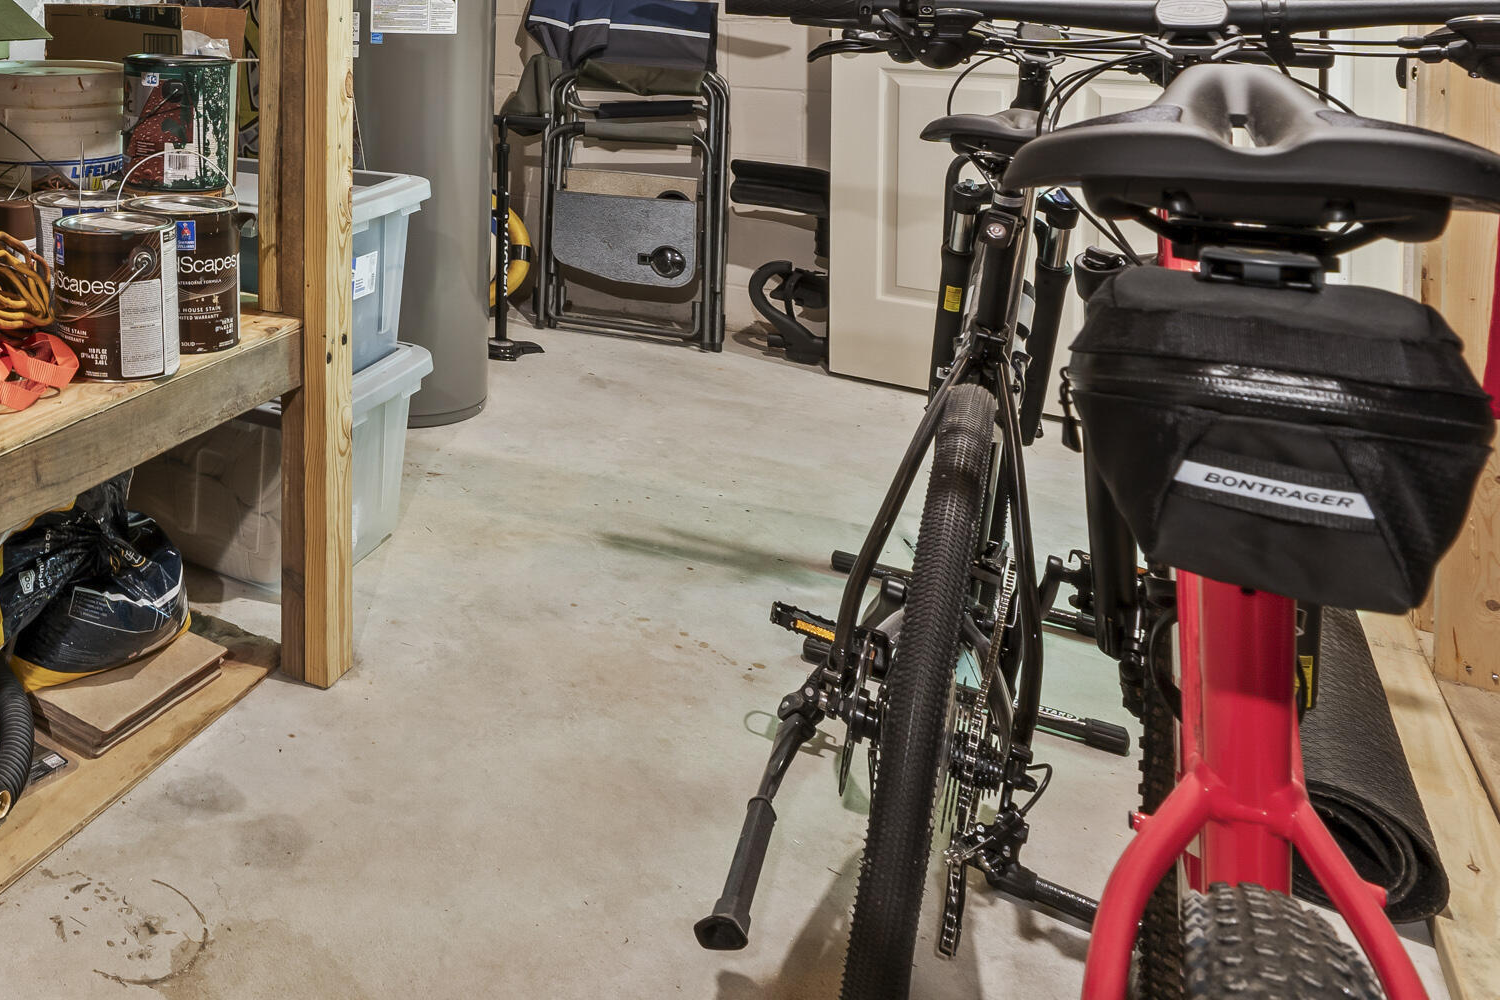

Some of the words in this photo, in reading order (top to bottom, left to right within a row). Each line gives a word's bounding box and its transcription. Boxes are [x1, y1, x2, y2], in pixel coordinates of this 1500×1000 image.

[177, 254, 237, 275] Scapes
[55, 270, 116, 296] Scapes
[193, 313, 219, 321] WARRANTY
[71, 327, 87, 336] STAIN
[1204, 471, 1355, 509] BONTRAGER
